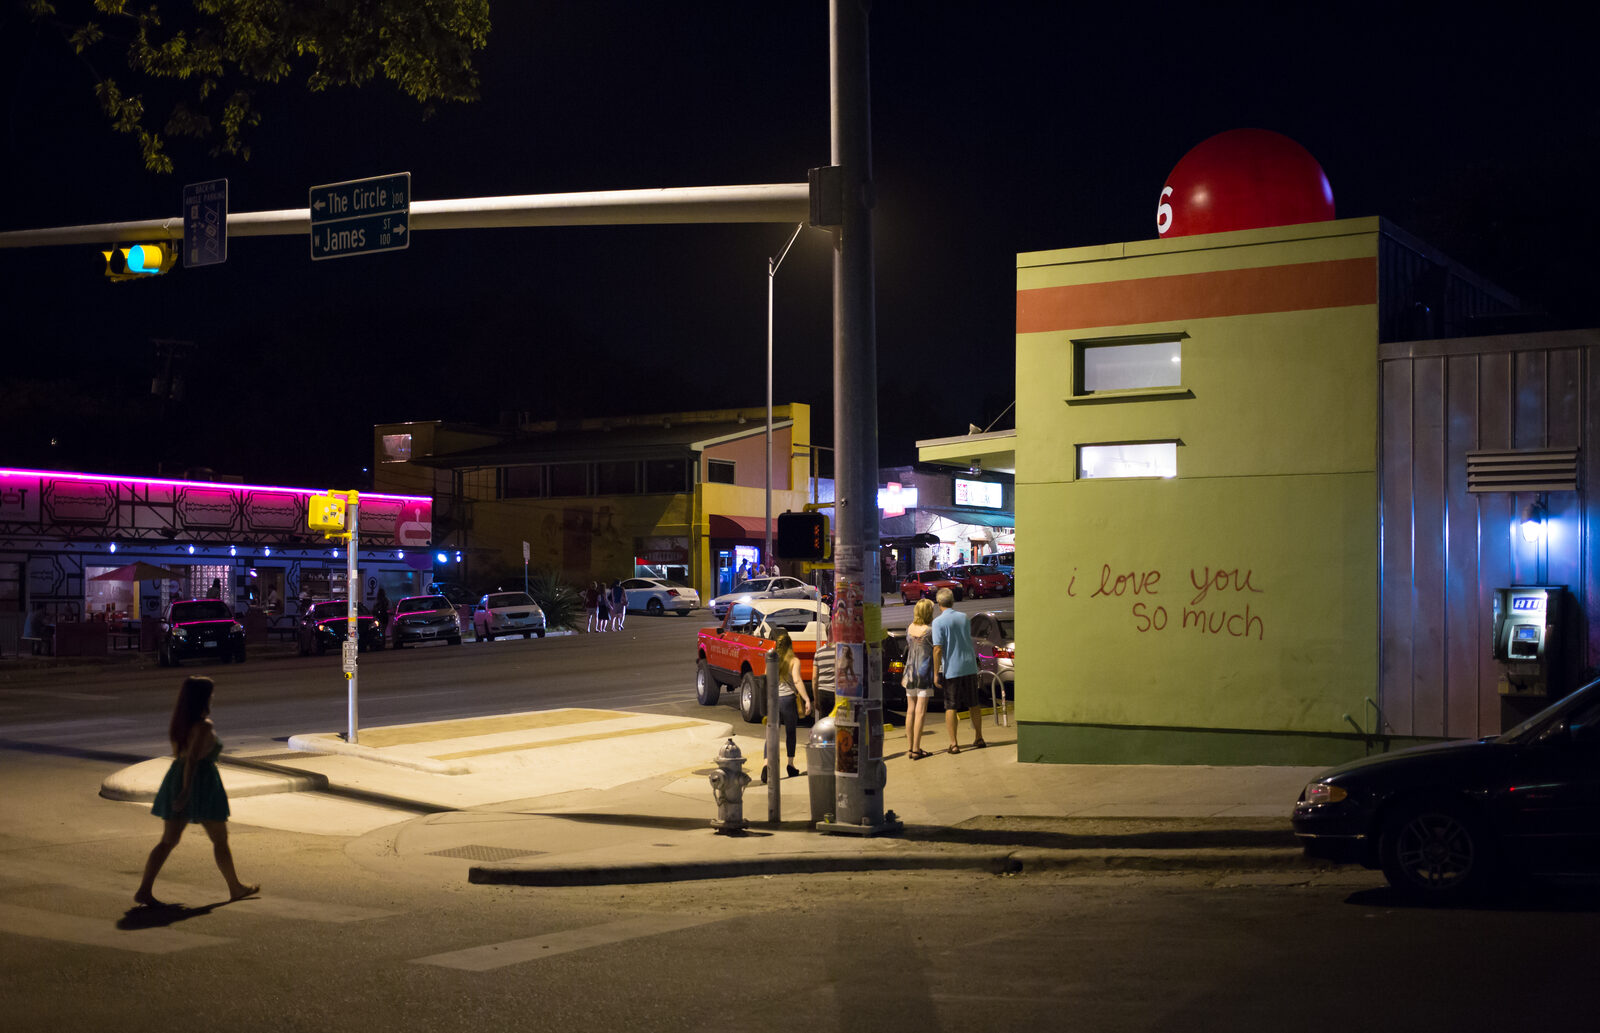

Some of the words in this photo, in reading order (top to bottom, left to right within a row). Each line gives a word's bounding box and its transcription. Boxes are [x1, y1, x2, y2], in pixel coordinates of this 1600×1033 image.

[328, 192, 348, 214] The
[353, 186, 387, 211] Circle
[1157, 186, 1173, 234] 6
[383, 217, 392, 230] ST
[323, 227, 366, 252] James
[380, 233, 391, 246] 100
[1067, 567, 1077, 597] i
[1090, 563, 1161, 598] love
[1190, 566, 1264, 605] you
[1183, 603, 1264, 641] much
